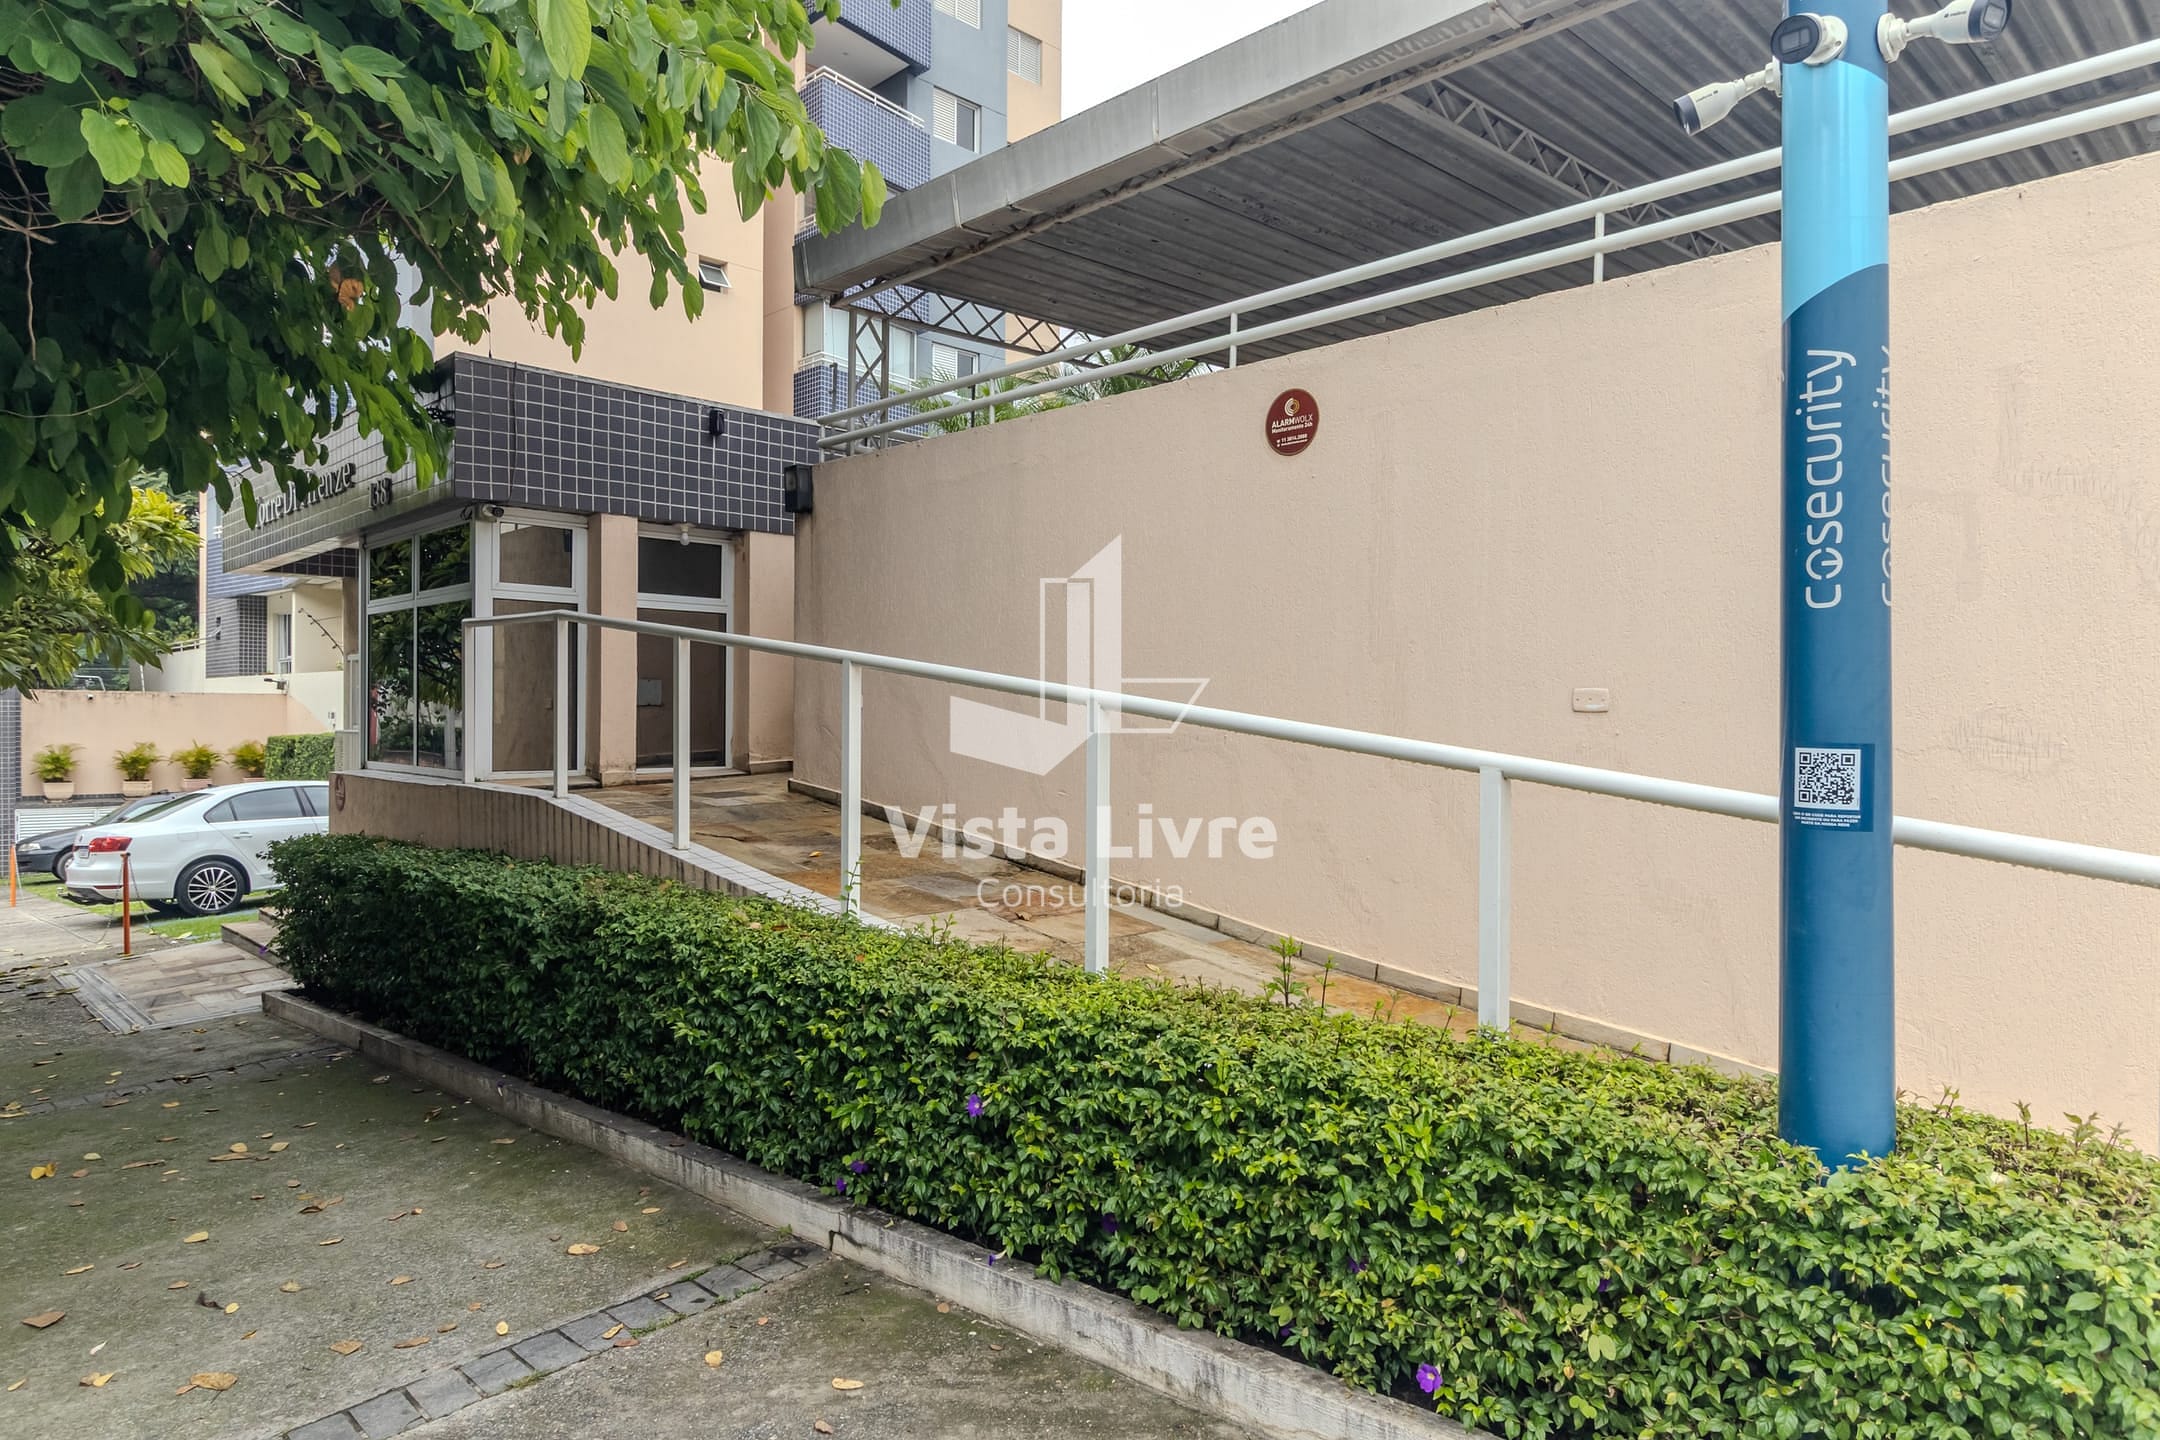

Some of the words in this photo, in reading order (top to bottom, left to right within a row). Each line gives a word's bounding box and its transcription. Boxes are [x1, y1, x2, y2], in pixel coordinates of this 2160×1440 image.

[254, 494, 283, 529] orre
[300, 462, 353, 507] ienze
[1795, 349, 1857, 609] cosecurity
